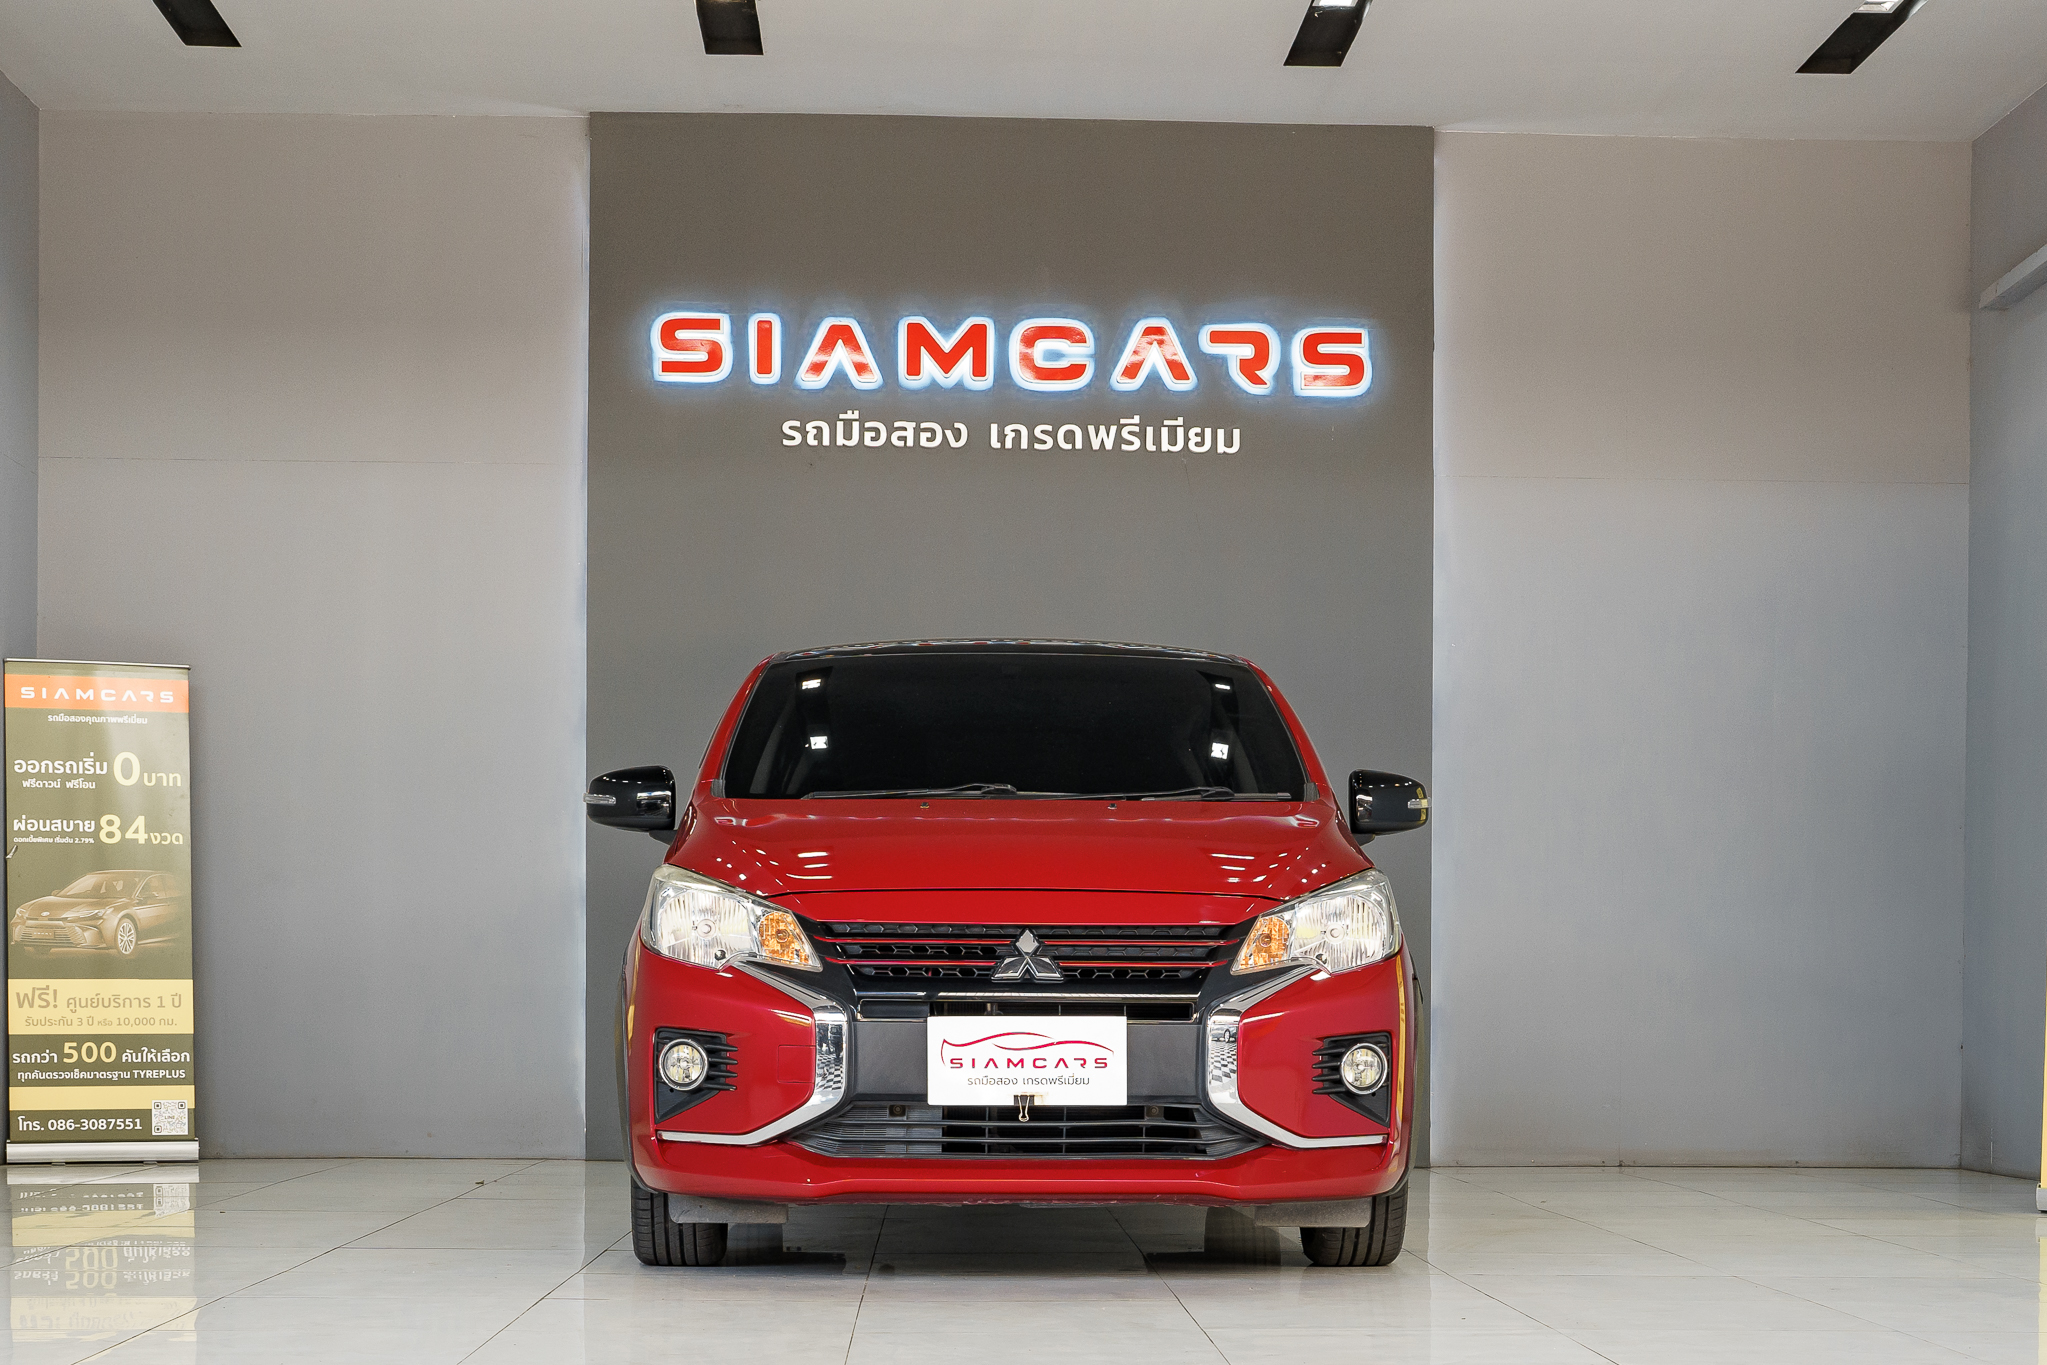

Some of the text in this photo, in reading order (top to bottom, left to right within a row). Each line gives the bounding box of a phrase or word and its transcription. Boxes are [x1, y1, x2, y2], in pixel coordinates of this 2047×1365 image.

[656, 315, 1368, 392] SIAMCARS
[781, 410, 1241, 455] รถมือสอง เกรดพรีเมียม
[21, 686, 174, 703] SIAMCARS
[14, 752, 108, 775] ออกรถเริ่ม
[22, 778, 96, 789] ฟรีดาวน์ ฟรีโอน
[13, 815, 96, 832] ผ่อนสบาย
[16, 985, 182, 1014] ฟรี! ศูนย์บริการ 1 ปี
[25, 1016, 73, 1027] รับประกัน
[77, 1017, 84, 1027] 3
[87, 1015, 94, 1027] ปี
[117, 1017, 156, 1028] 10,000
[159, 1018, 178, 1027] กม.
[12, 1041, 191, 1064] รถกว่า 500 คันให้เลือก
[950, 1057, 1108, 1069] SIAMCARS
[132, 1069, 186, 1079] TYREPLUS
[967, 1074, 1018, 1086] รถมือสอง
[18, 1116, 143, 1131] โทร. 086-3087551
